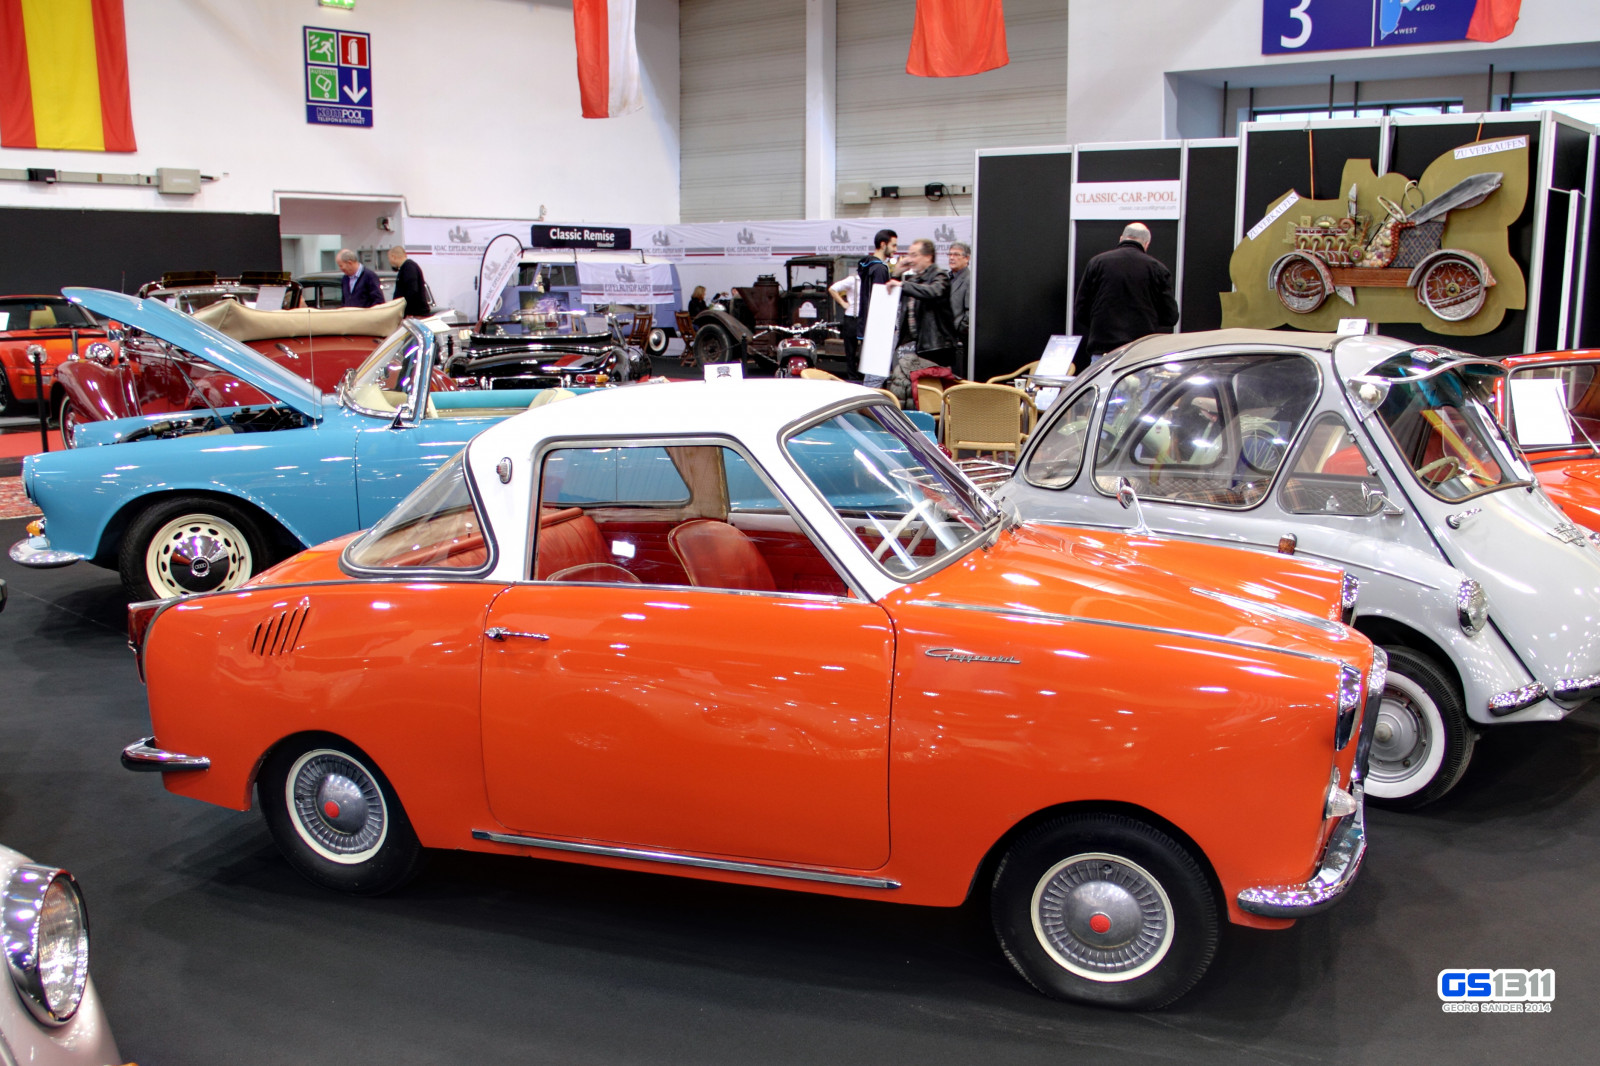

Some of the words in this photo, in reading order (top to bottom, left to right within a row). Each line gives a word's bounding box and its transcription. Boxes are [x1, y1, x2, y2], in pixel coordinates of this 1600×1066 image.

[1421, 3, 1436, 12] SÜD
[1280, 0, 1313, 48] 3
[1399, 26, 1418, 35] WEST
[1455, 150, 1468, 158] ZU
[1469, 139, 1525, 155] VERKAUFEN
[1075, 191, 1177, 204] CLASSIC-CAR-POOL
[1257, 196, 1298, 230] VERKAUFEN
[549, 227, 582, 240] Classic
[583, 229, 615, 241] Remise
